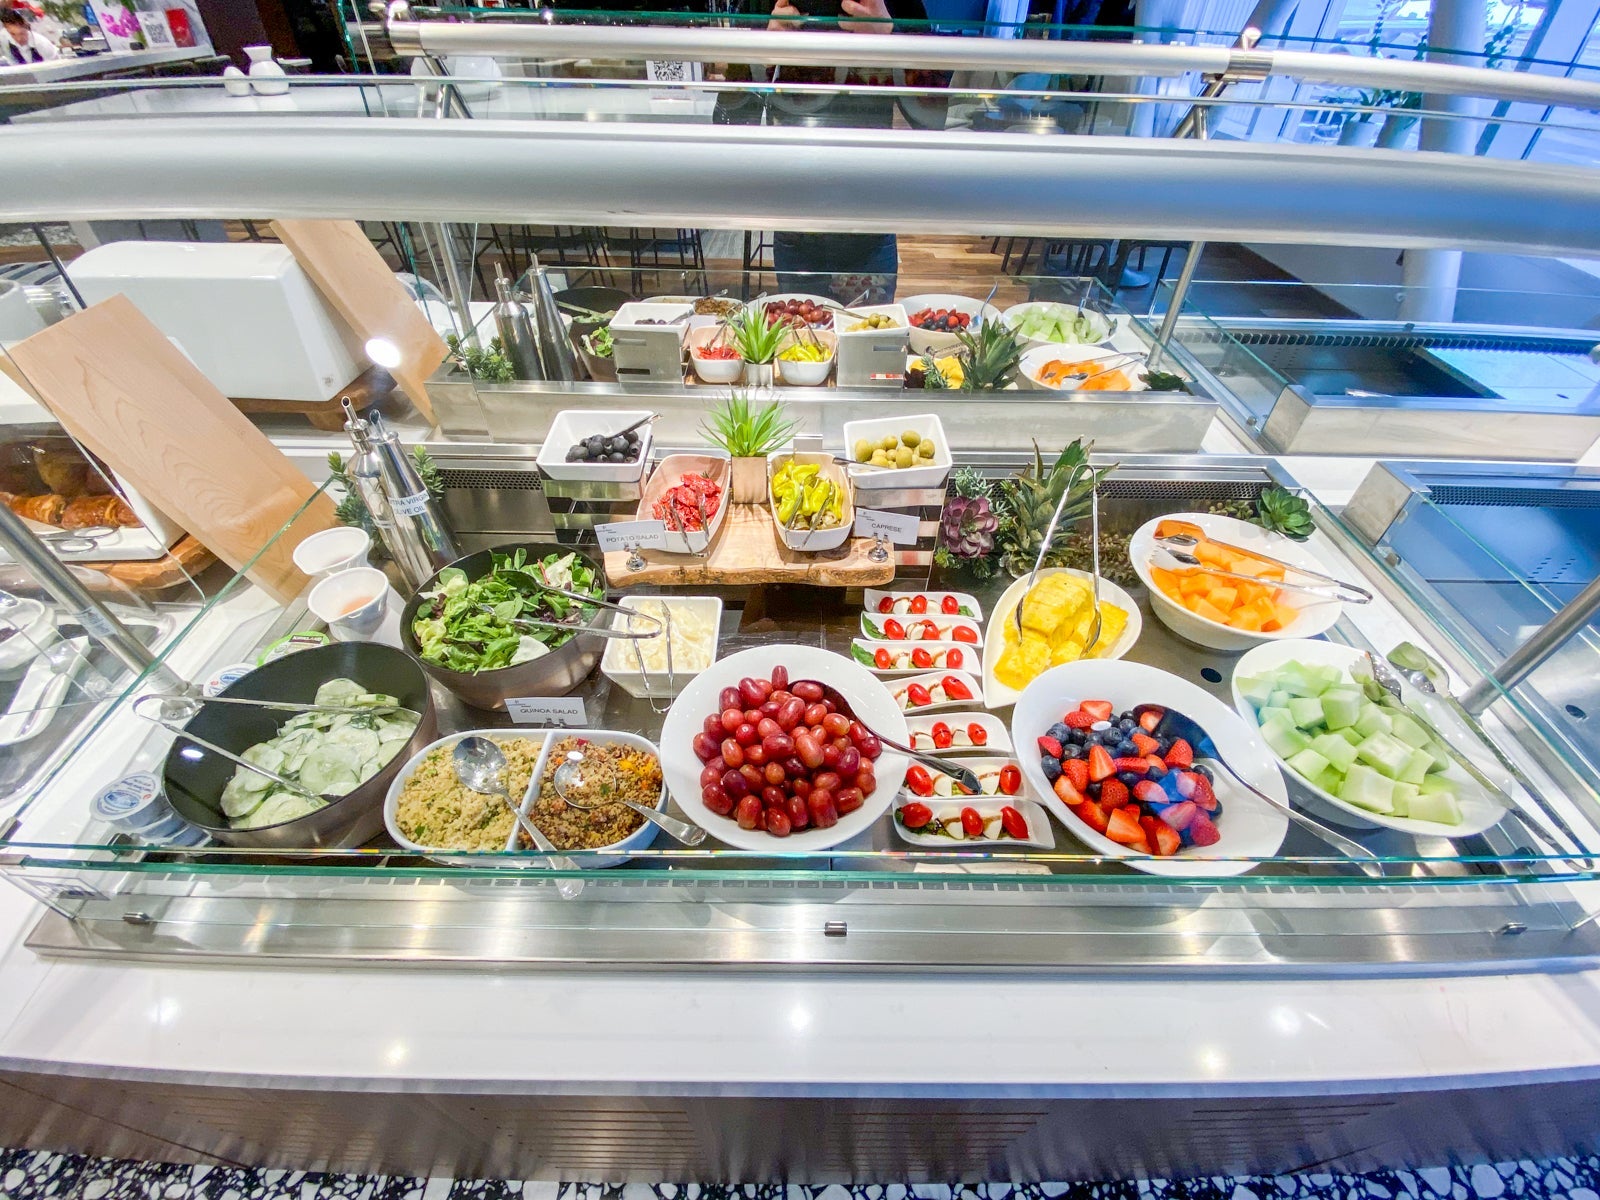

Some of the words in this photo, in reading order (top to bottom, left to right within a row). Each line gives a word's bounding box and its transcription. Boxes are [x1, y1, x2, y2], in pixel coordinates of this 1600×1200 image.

[871, 522, 903, 533] CAPRESE
[606, 534, 635, 543] POTATO
[636, 533, 659, 541] SALAD
